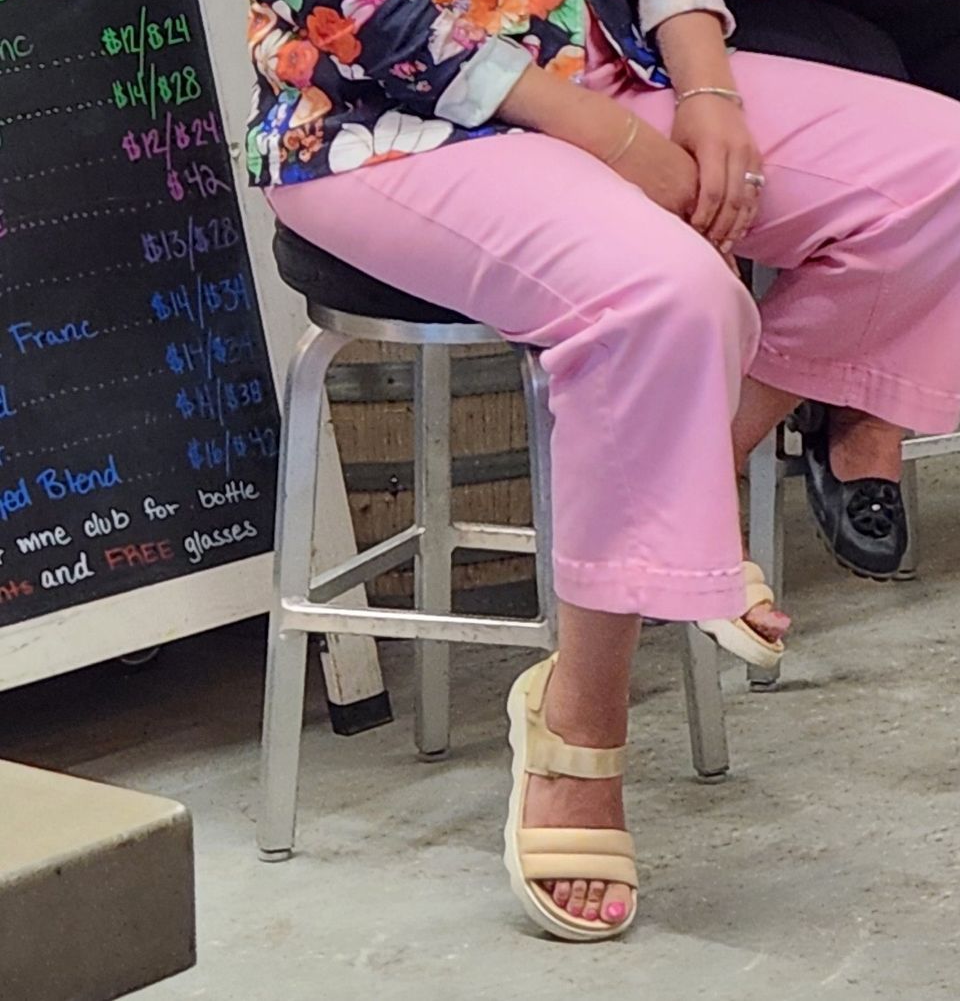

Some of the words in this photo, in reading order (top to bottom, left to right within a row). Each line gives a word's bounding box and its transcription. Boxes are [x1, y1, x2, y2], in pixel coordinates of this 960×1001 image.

[167, 161, 232, 201] $42
[8, 320, 99, 354] Franc
[36, 454, 122, 499] Blend
[84, 508, 130, 537] club
[144, 497, 180, 520] for
[198, 480, 260, 508] bottle
[41, 552, 95, 588] and
[104, 540, 175, 569] FREE
[184, 520, 258, 564] glasses
